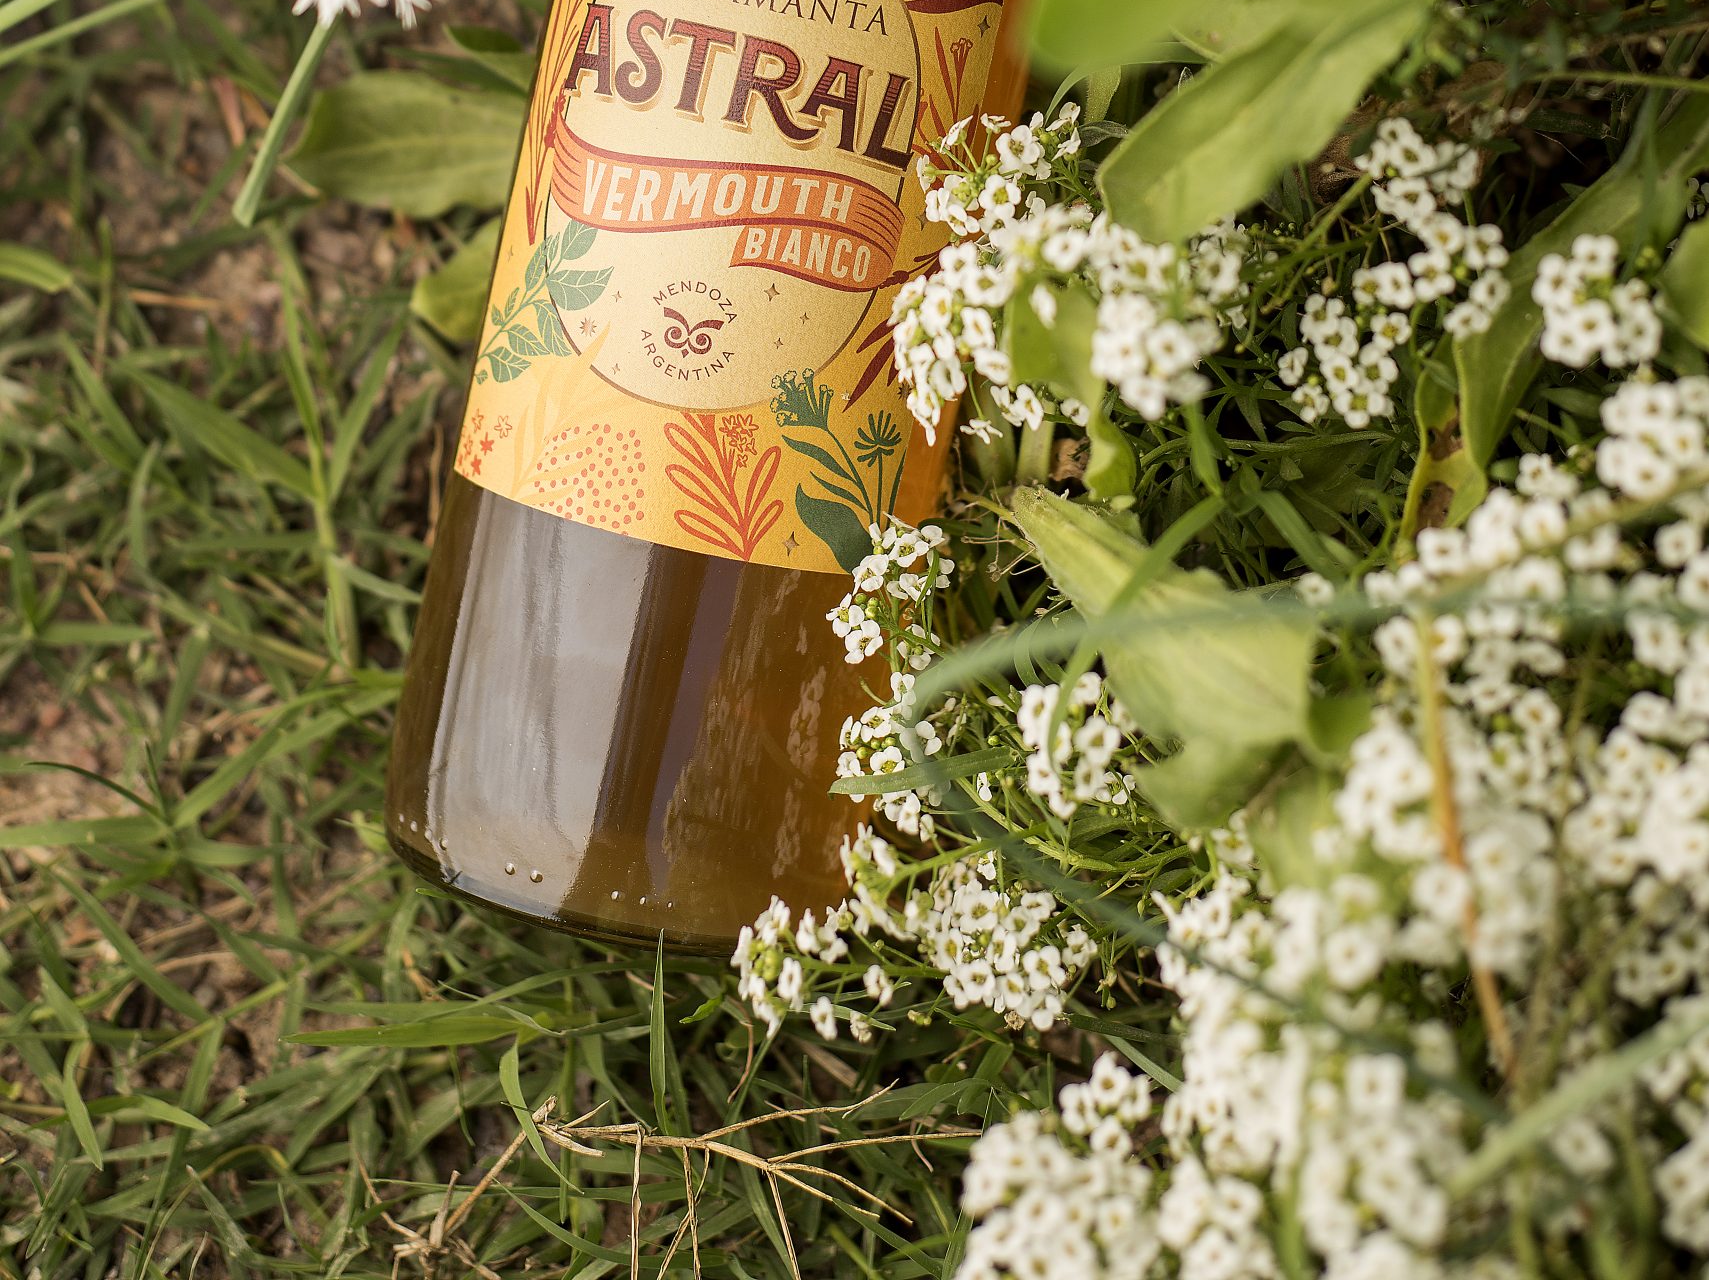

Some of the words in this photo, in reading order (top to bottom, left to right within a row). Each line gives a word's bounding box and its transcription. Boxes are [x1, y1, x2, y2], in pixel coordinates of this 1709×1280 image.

[564, 3, 914, 172] ASTRAL
[582, 157, 853, 224] VERMOUTH
[742, 227, 871, 283] BIANCO
[652, 280, 738, 324] MENDOZA
[640, 329, 736, 381] ARGENTINA
